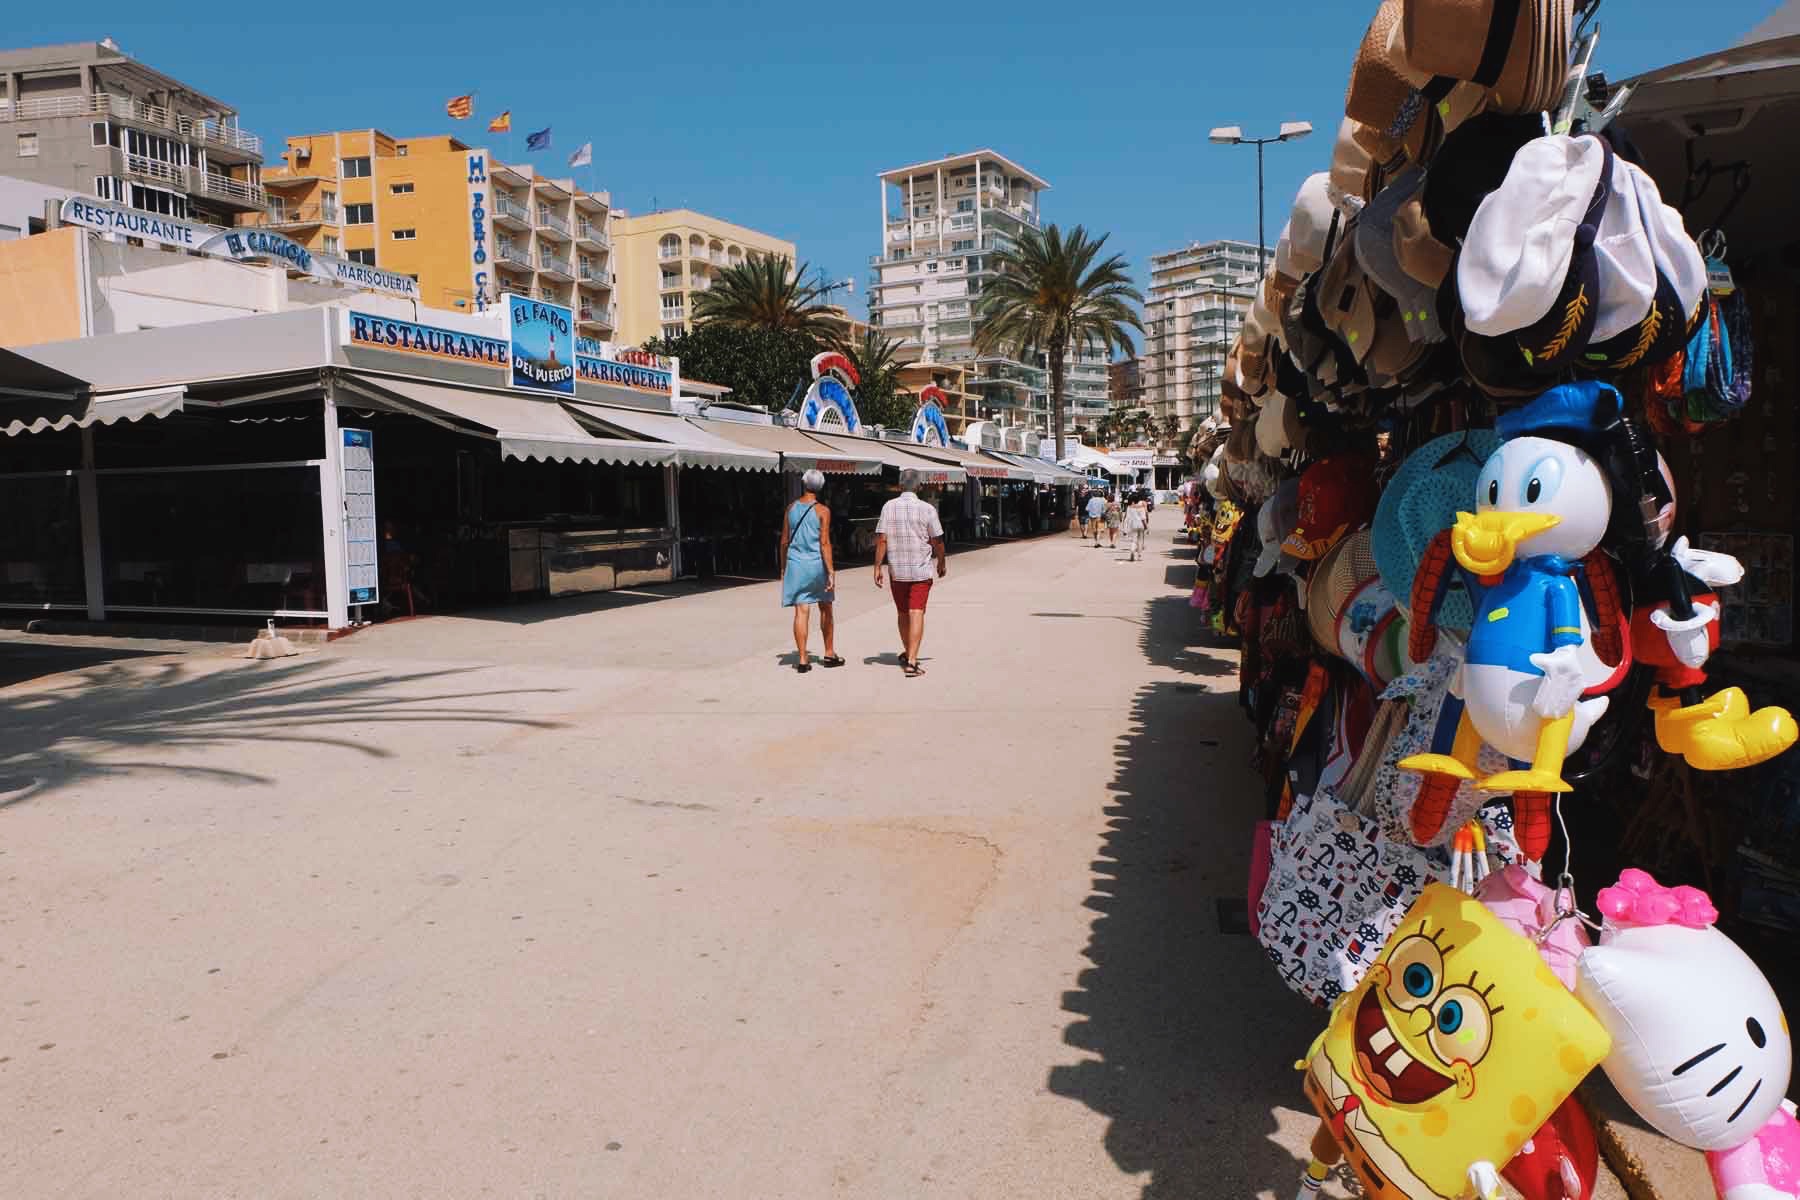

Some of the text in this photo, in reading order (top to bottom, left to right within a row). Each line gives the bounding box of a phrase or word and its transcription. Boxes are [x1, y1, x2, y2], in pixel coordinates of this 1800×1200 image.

[73, 201, 193, 243] RESTAURANTE
[472, 192, 486, 264] PORTO
[336, 263, 413, 293] MARISQUERIA
[513, 303, 569, 336] EL FARO
[353, 316, 508, 364] RESTAURANTE
[515, 355, 572, 383] DEL PUERTO
[579, 359, 669, 391] MARISQUERIA
